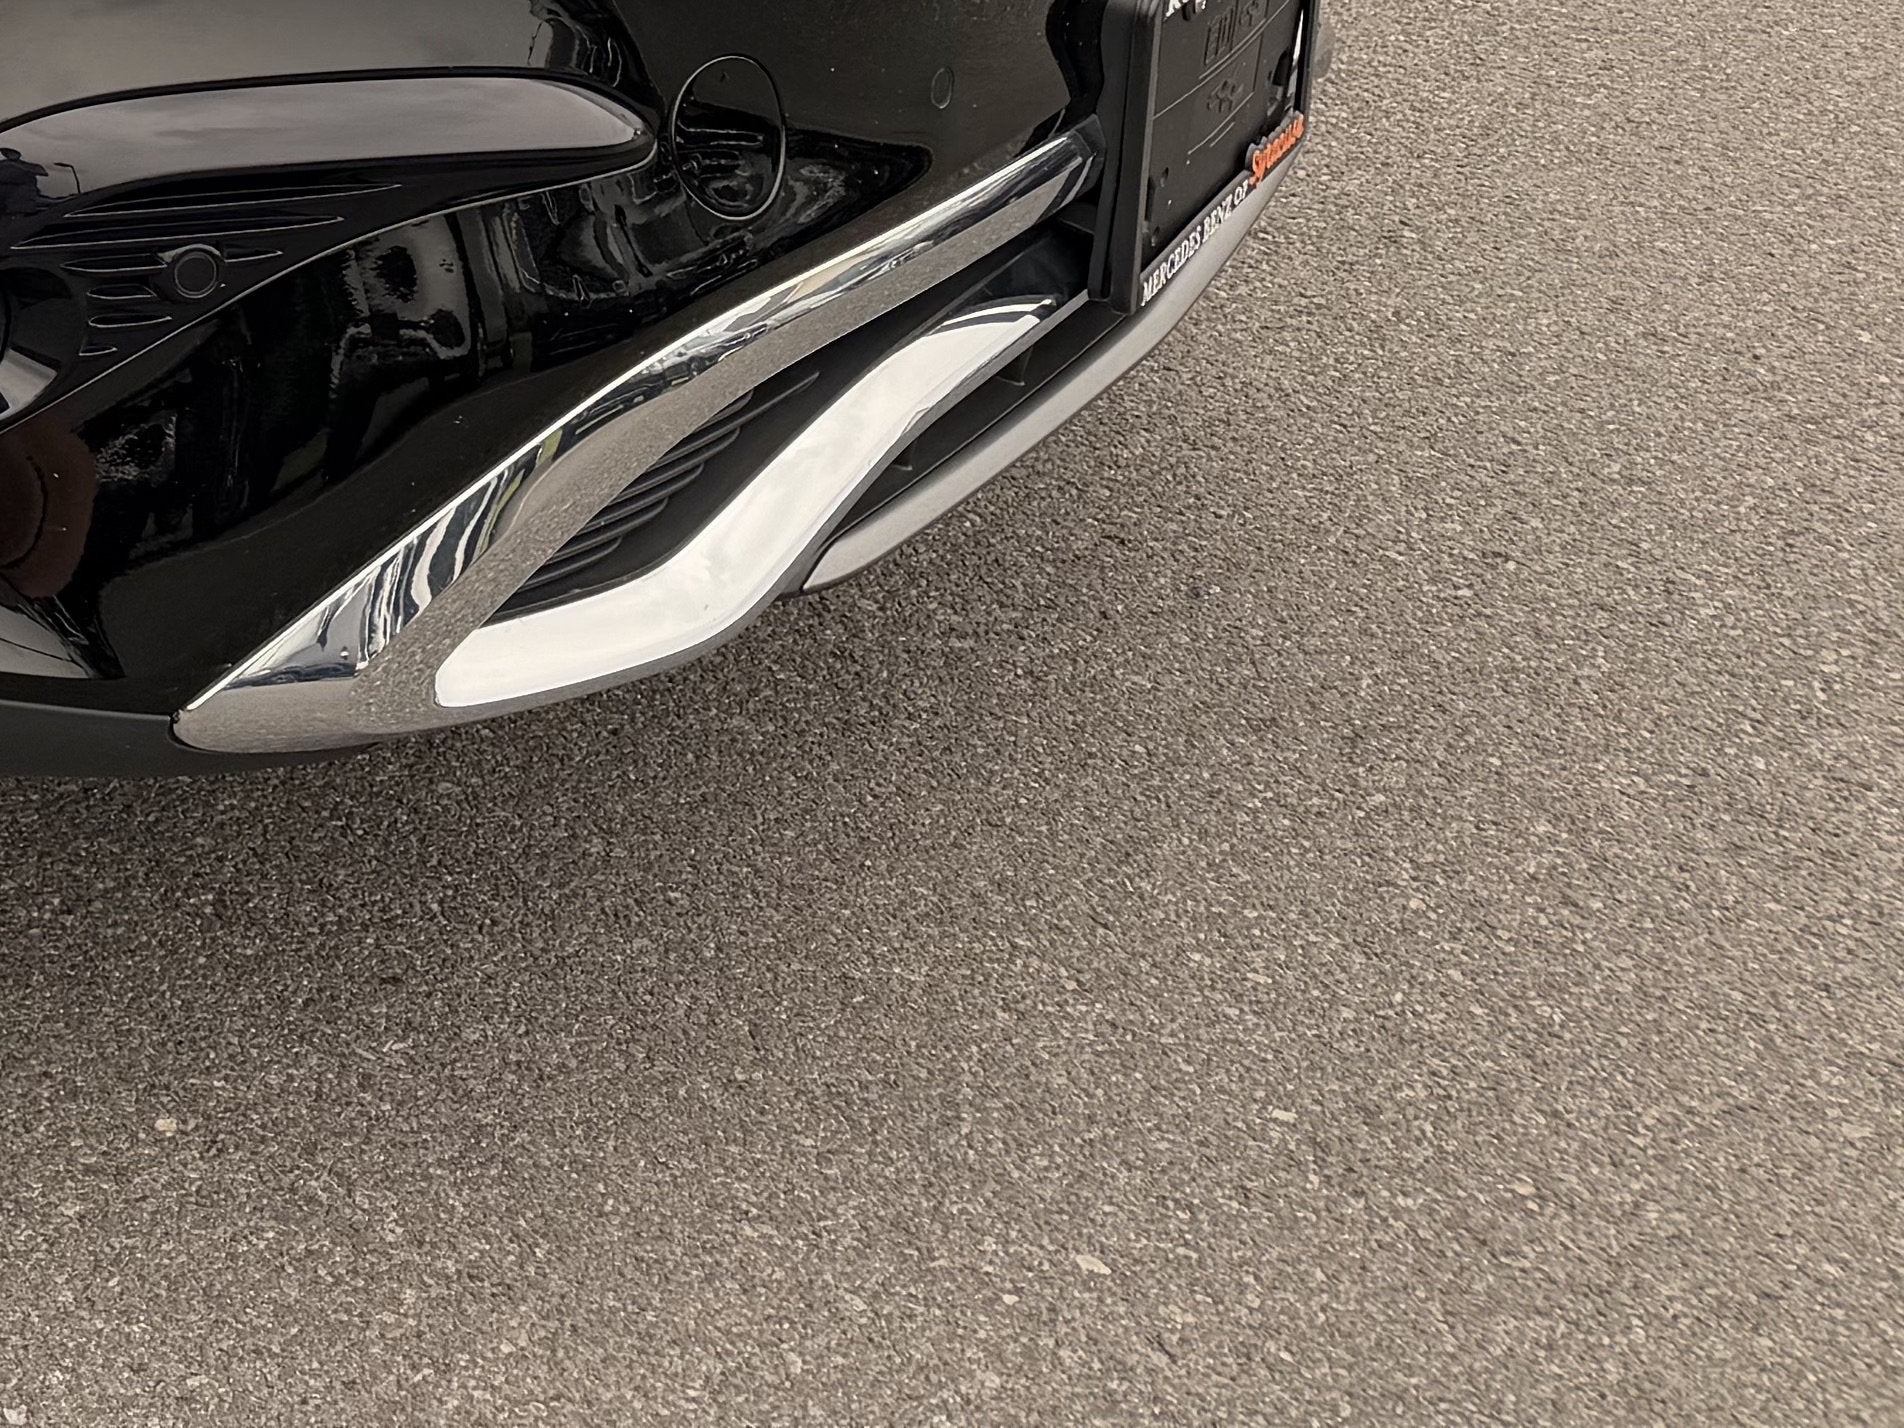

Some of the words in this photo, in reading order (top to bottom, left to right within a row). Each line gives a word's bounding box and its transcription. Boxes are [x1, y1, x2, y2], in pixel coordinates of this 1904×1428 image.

[1140, 225, 1202, 307] MERCEDES
[1202, 197, 1234, 244] BENZ
[1234, 179, 1249, 205] OF
